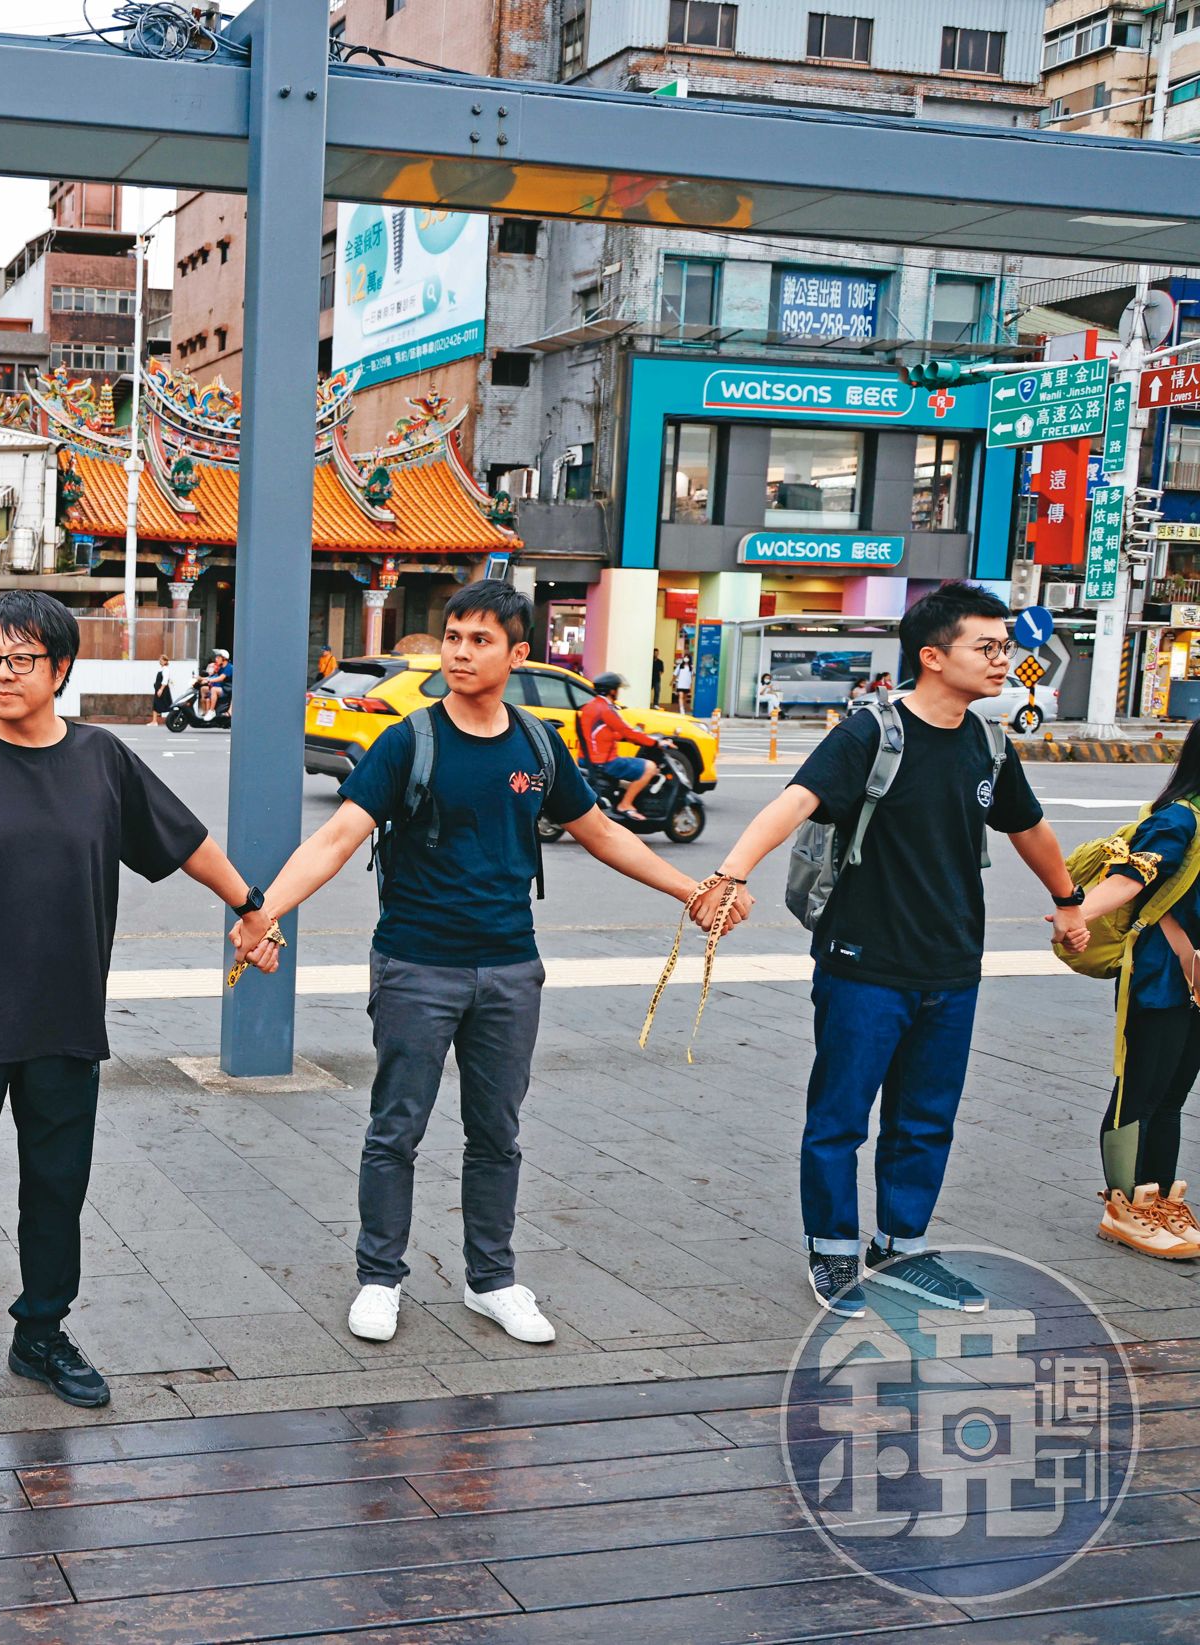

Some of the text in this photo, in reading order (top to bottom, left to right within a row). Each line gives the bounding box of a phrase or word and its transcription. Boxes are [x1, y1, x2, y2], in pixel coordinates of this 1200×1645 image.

[782, 275, 876, 311] 辦公室出租 130坪
[782, 309, 873, 343] 0932-258-285
[1023, 381, 1032, 393] 2
[1170, 367, 1200, 389] 情人
[720, 380, 832, 404] watsons
[845, 385, 899, 407] 屈臣氏
[1170, 391, 1192, 403] Lovers
[1036, 400, 1101, 427] 高速公路
[1109, 397, 1125, 454] 忠一路
[1041, 422, 1092, 438] FREEWAY
[1047, 469, 1067, 525] 遠傳
[755, 539, 841, 560] watsons
[851, 541, 893, 561] 屈臣氏
[1087, 490, 1108, 597] 請依燈號行駛
[1100, 489, 1122, 597] 多時相號誌
